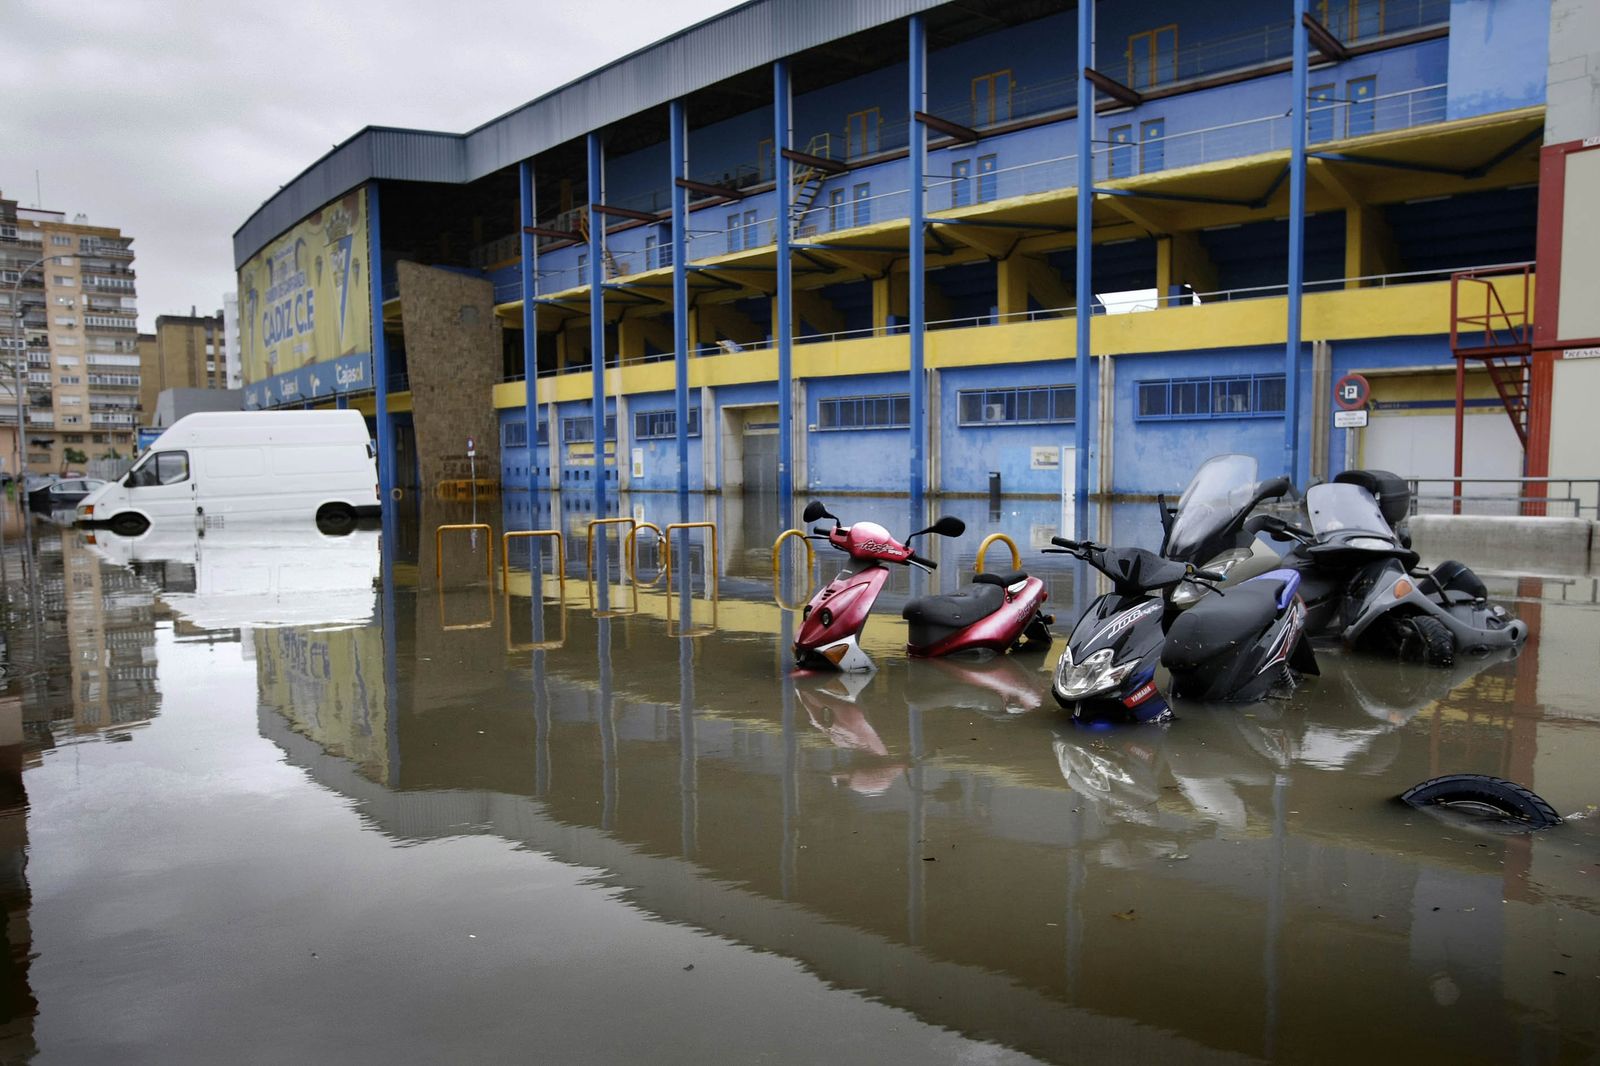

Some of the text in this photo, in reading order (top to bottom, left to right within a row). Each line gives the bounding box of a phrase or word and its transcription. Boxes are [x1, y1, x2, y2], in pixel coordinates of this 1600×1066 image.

[335, 361, 363, 389] Cajasol
[1346, 387, 1355, 398] P
[1130, 685, 1152, 702] YAMAHA
